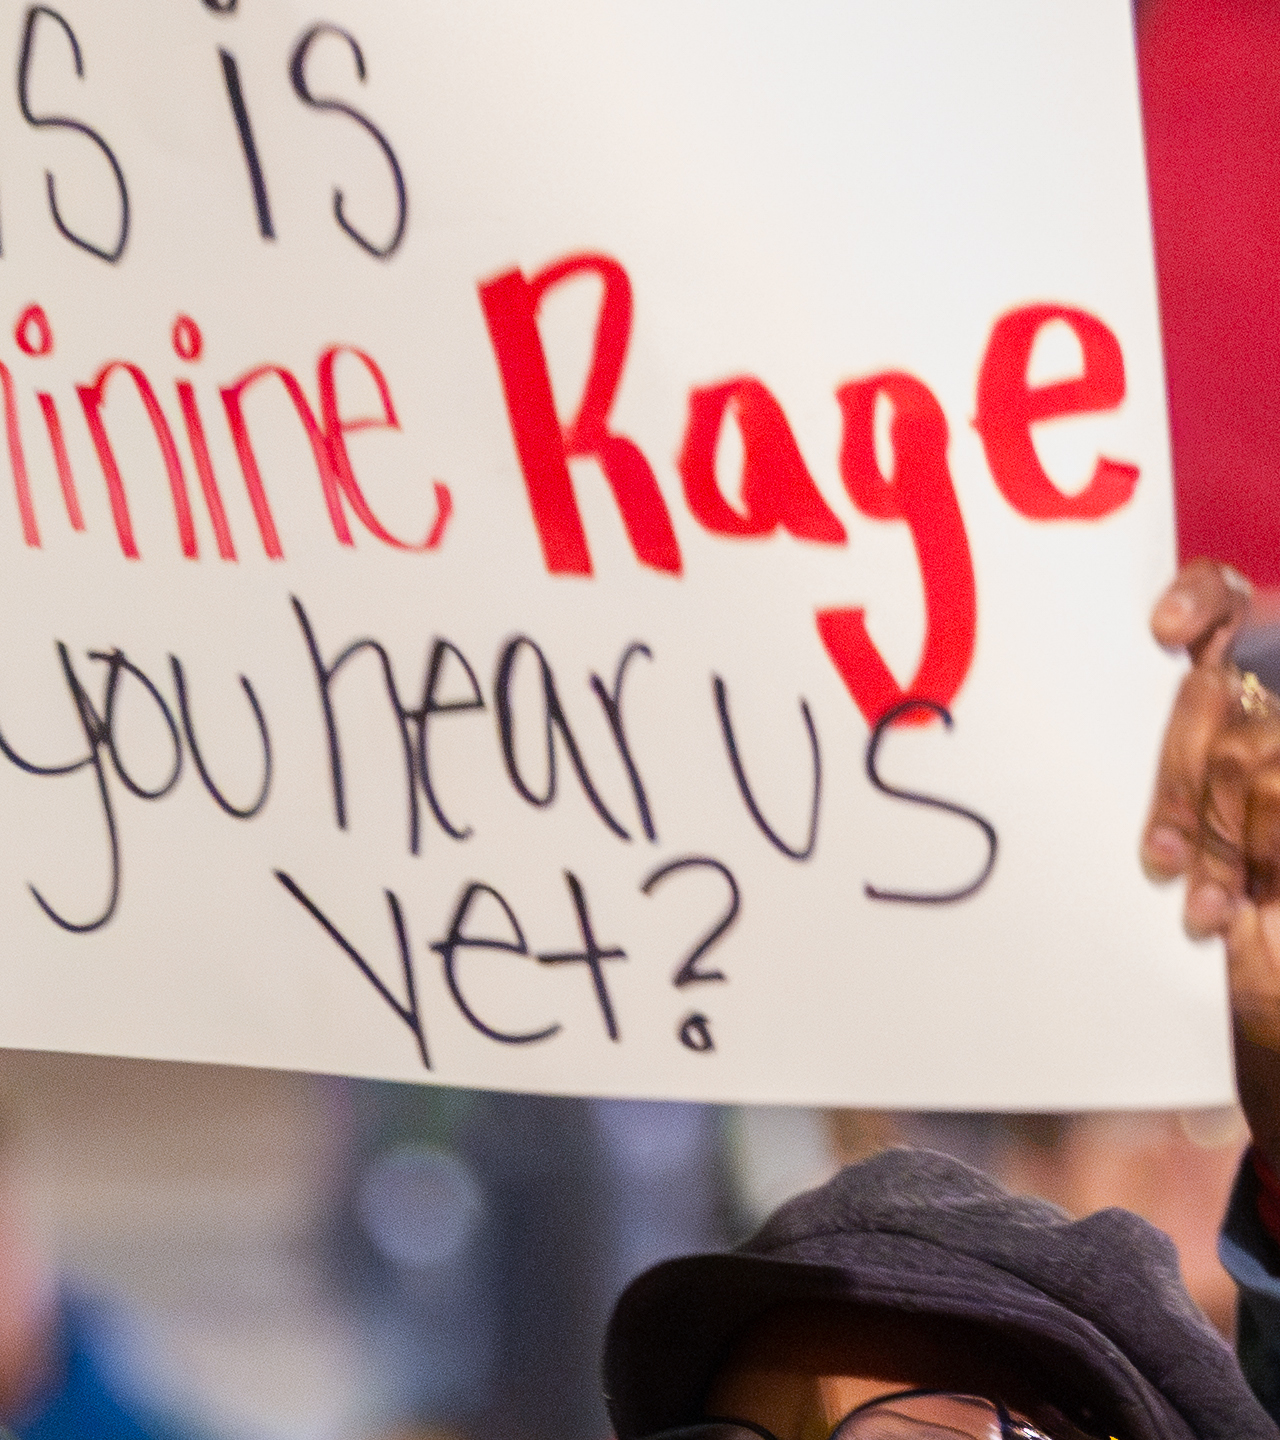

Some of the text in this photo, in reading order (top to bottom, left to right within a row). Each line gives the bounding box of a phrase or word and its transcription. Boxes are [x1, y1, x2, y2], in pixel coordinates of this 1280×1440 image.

[477, 251, 1140, 730] Rage
[292, 595, 656, 855] hear
[714, 674, 998, 904] us
